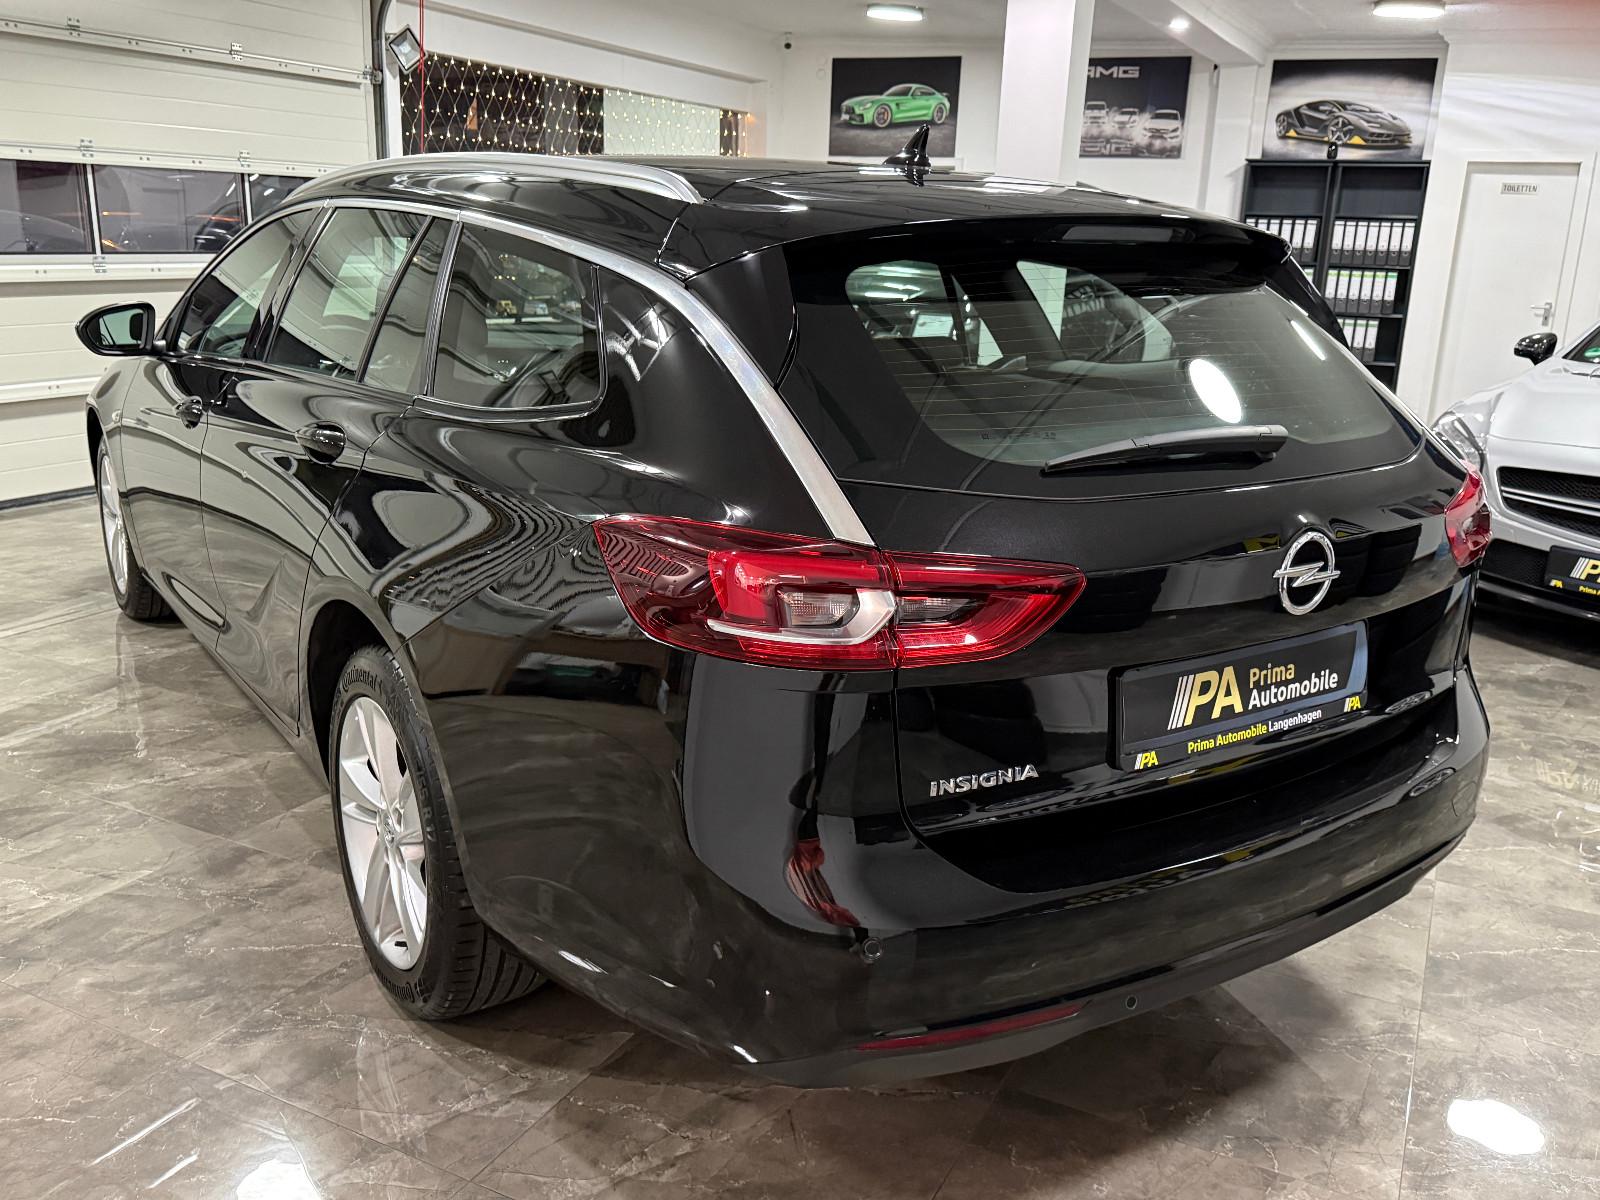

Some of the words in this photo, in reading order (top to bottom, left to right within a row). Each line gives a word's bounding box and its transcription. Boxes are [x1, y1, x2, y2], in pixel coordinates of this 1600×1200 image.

[1183, 665, 1244, 727] PA
[1248, 669, 1339, 710] Automobile
[1250, 663, 1295, 688] Prima
[1188, 740, 1215, 754] Prima
[1216, 723, 1268, 746] Automobile
[1268, 709, 1322, 732] Langenhagen
[929, 764, 1040, 797] INSIGNIA
